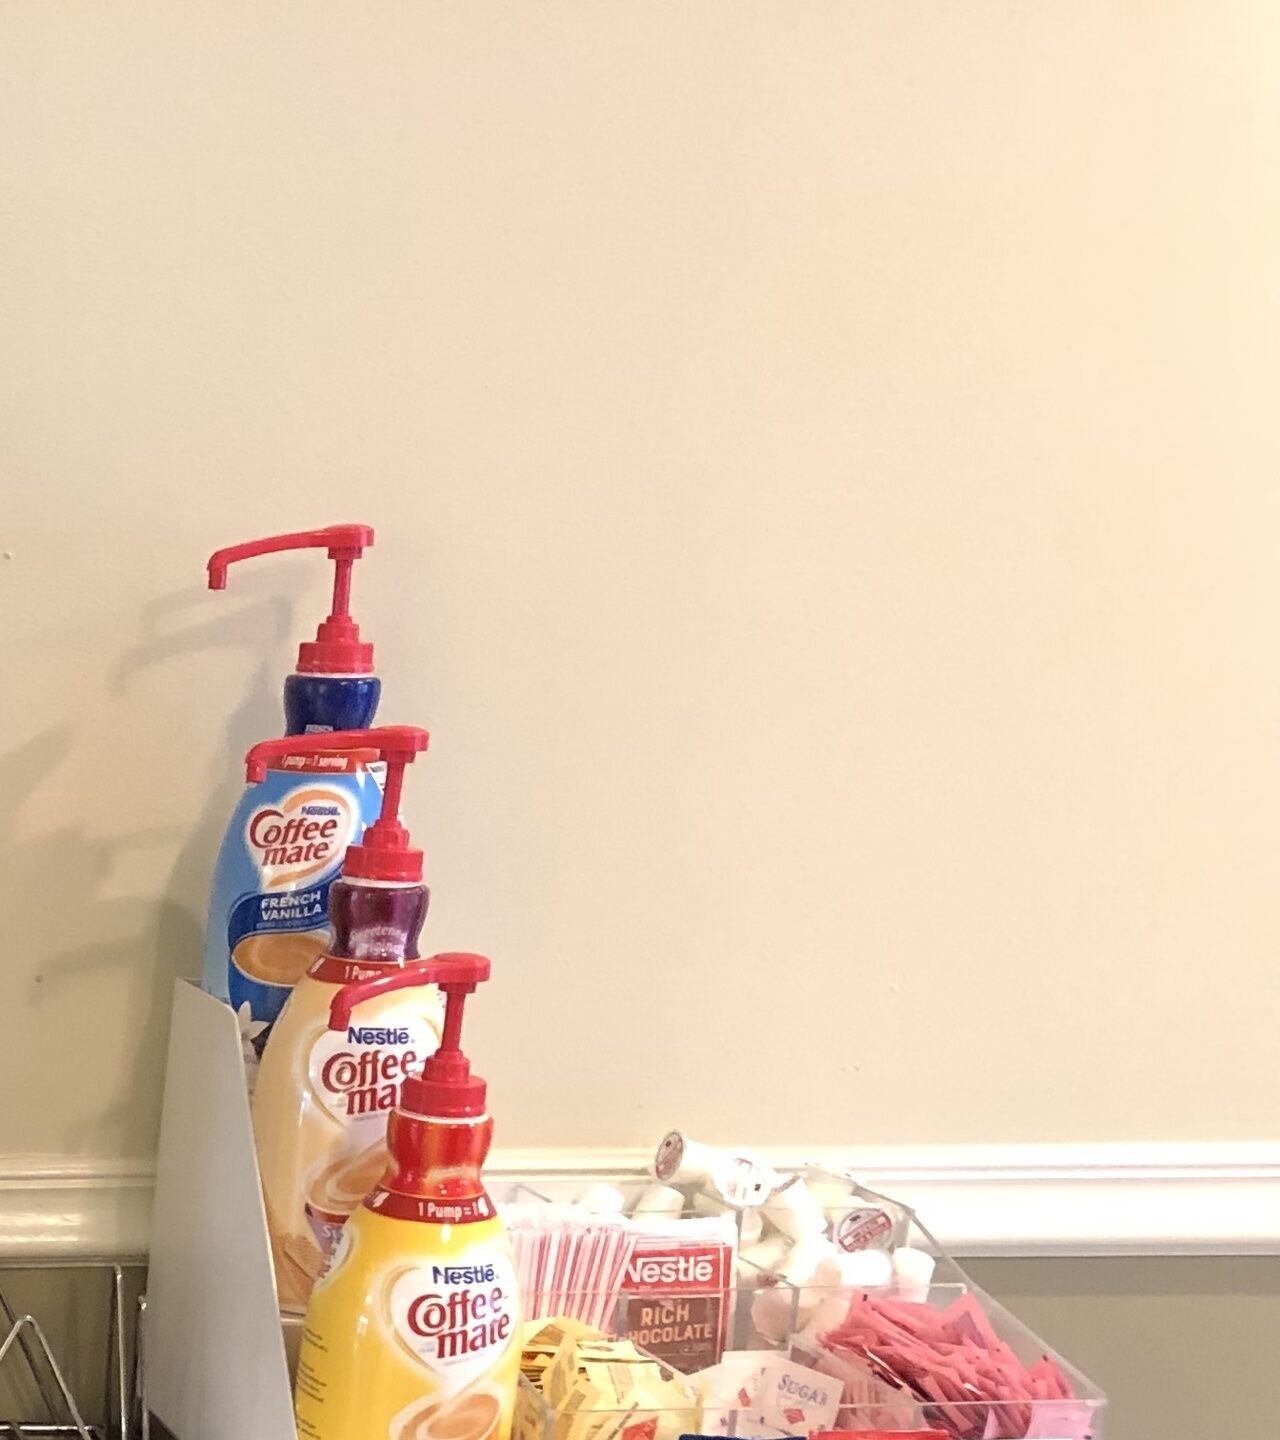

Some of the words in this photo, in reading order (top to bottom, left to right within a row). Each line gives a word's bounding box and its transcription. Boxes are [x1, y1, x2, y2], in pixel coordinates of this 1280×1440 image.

[249, 809, 337, 848] Coffee
[262, 840, 330, 867] mate
[260, 890, 322, 909] FRENCH
[261, 903, 323, 921] VANILLA
[347, 1026, 409, 1045] Nestlé
[321, 1049, 417, 1094] Coffee
[346, 1083, 397, 1115] ma
[418, 1202, 424, 1216] 1
[427, 1202, 462, 1221] Pump
[432, 1263, 495, 1285] Nestlé
[626, 1254, 713, 1283] Nestlé
[407, 1286, 503, 1337] Coffee
[640, 1303, 690, 1327] RICH
[437, 1313, 510, 1358] mate
[627, 1323, 714, 1346] HOCOLATE
[777, 1374, 829, 1407] SUGAR
